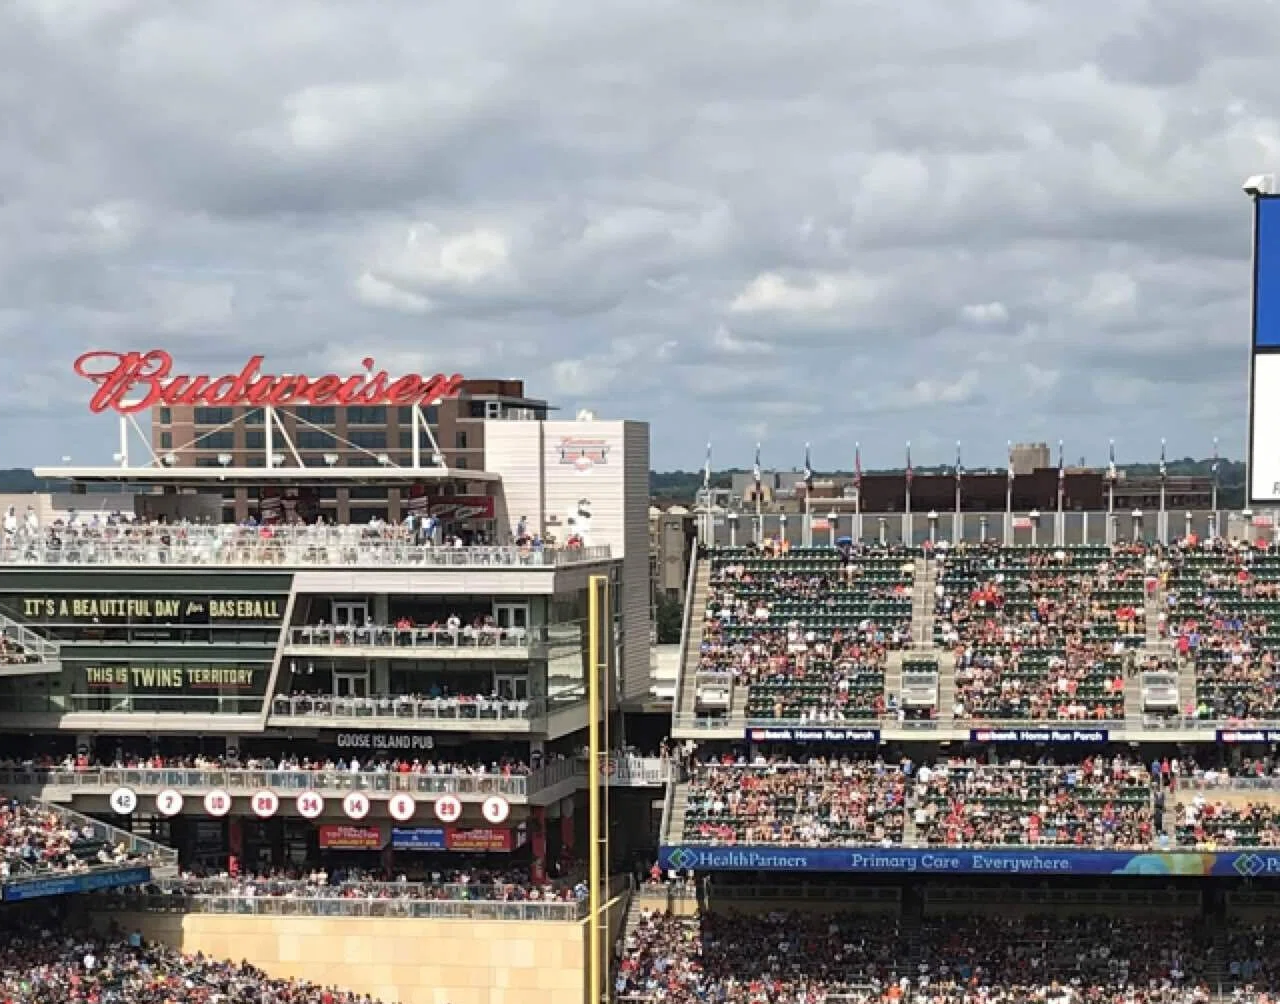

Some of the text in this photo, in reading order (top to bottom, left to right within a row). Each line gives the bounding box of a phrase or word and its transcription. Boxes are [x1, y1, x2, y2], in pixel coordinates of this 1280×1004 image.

[73, 348, 464, 414] Budweiser
[23, 599, 55, 617] IT'S
[59, 599, 69, 617] A
[73, 599, 153, 617] BEAUTIFUL
[155, 600, 181, 617] DAY
[209, 599, 280, 618] BASEBALL
[86, 667, 254, 687] THIS IS TWINS TERRITORY
[336, 733, 435, 749] GOOSE ISLAND PUB
[795, 730, 822, 741] Home
[825, 730, 845, 741] Run
[847, 730, 875, 741] Porch
[1021, 730, 1049, 741] Home
[1052, 730, 1071, 741] Run
[1073, 730, 1103, 741] Porch
[116, 794, 131, 807] 42
[165, 795, 173, 808] 7
[303, 797, 319, 811] 34
[350, 798, 364, 811] 14
[397, 801, 406, 813] 6
[491, 802, 500, 816] 3
[699, 853, 808, 867] HealthPartners
[852, 853, 918, 870] Primary
[921, 855, 961, 869] Care
